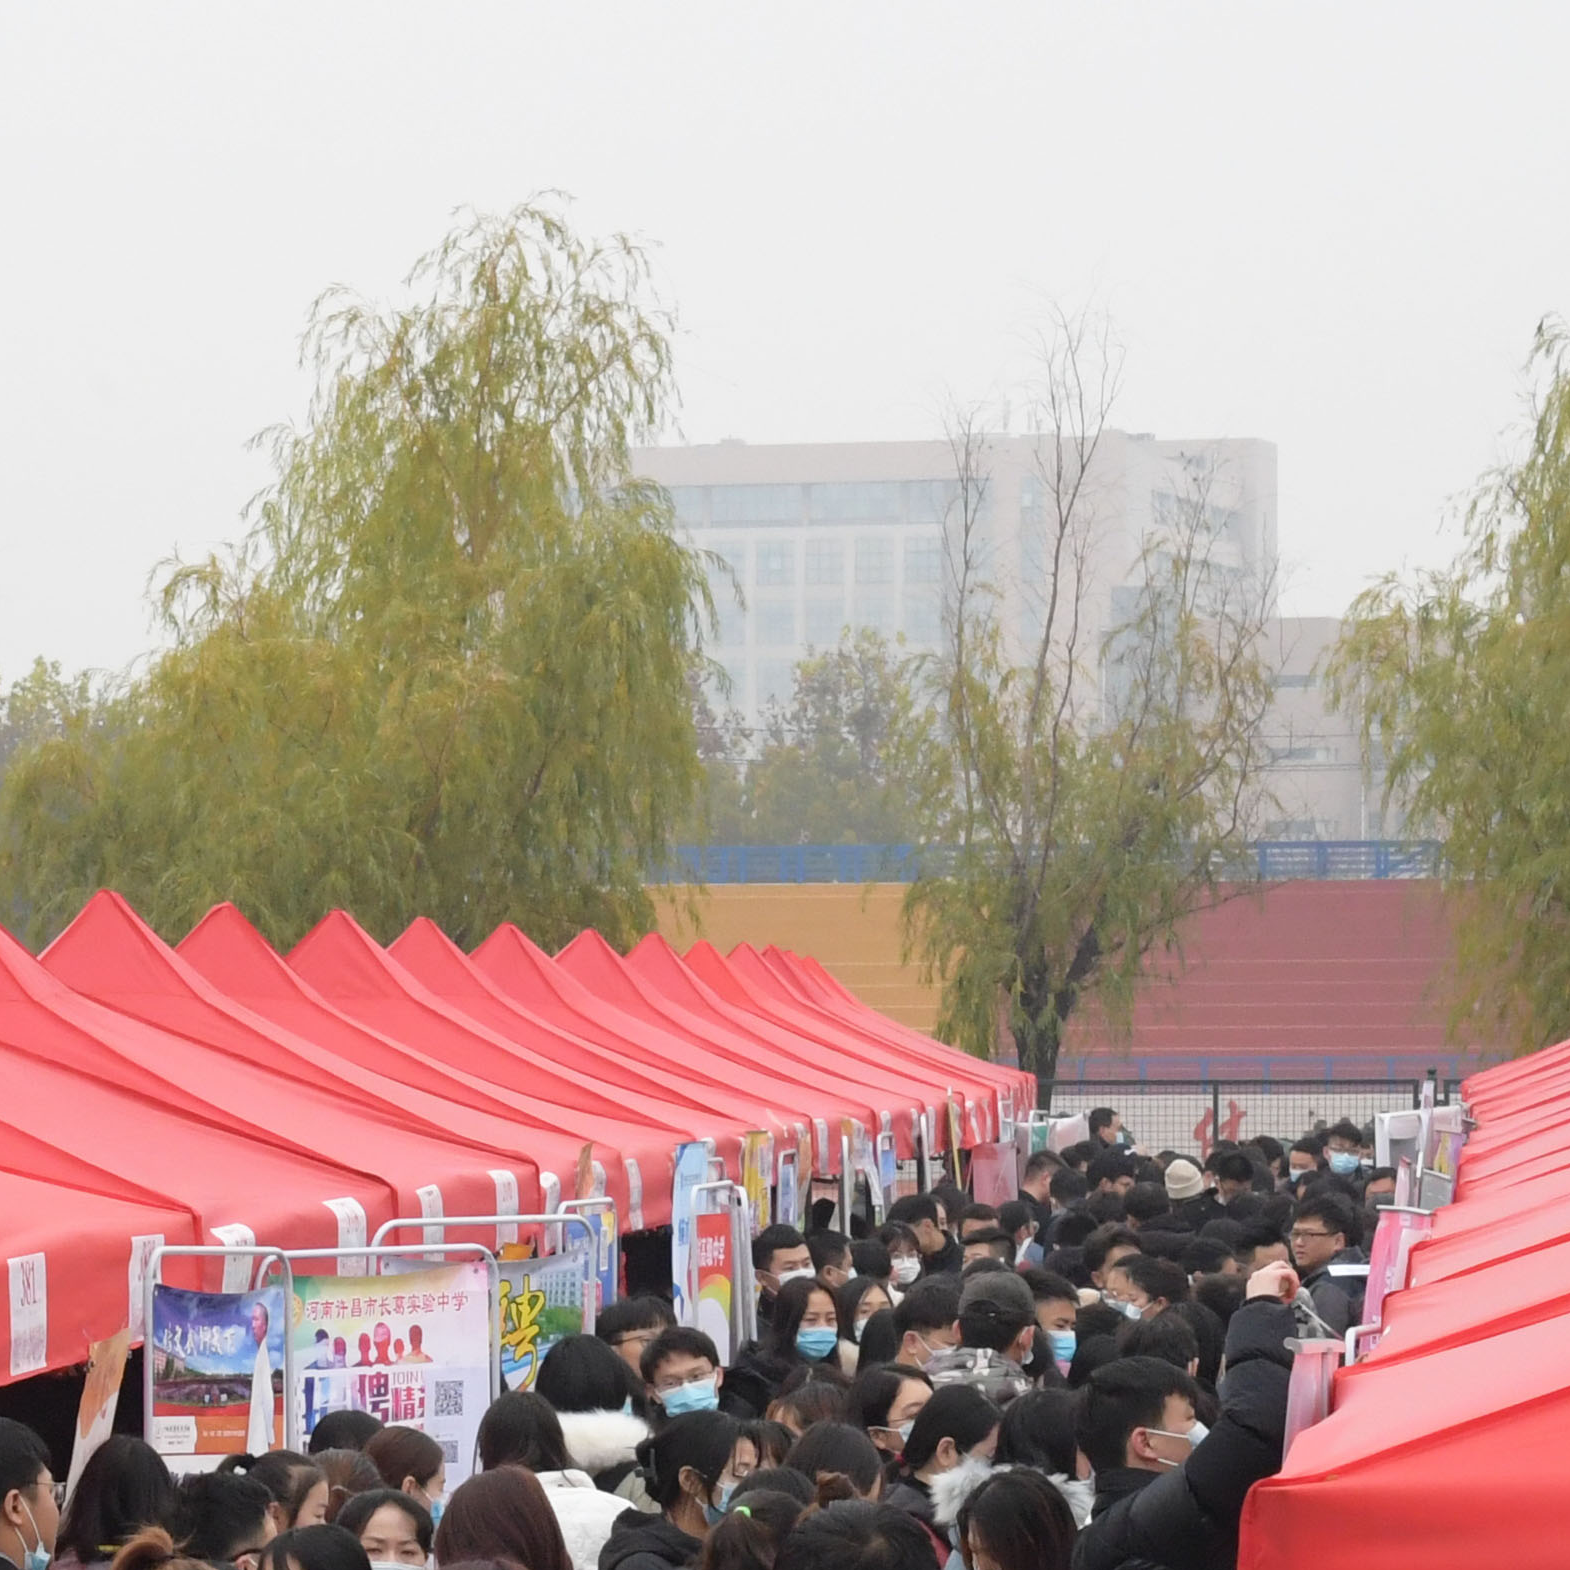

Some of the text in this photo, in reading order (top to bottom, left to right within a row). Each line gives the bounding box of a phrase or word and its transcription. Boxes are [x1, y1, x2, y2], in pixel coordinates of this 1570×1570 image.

[306, 1290, 469, 1321] 河南许昌市长葛实验中学
